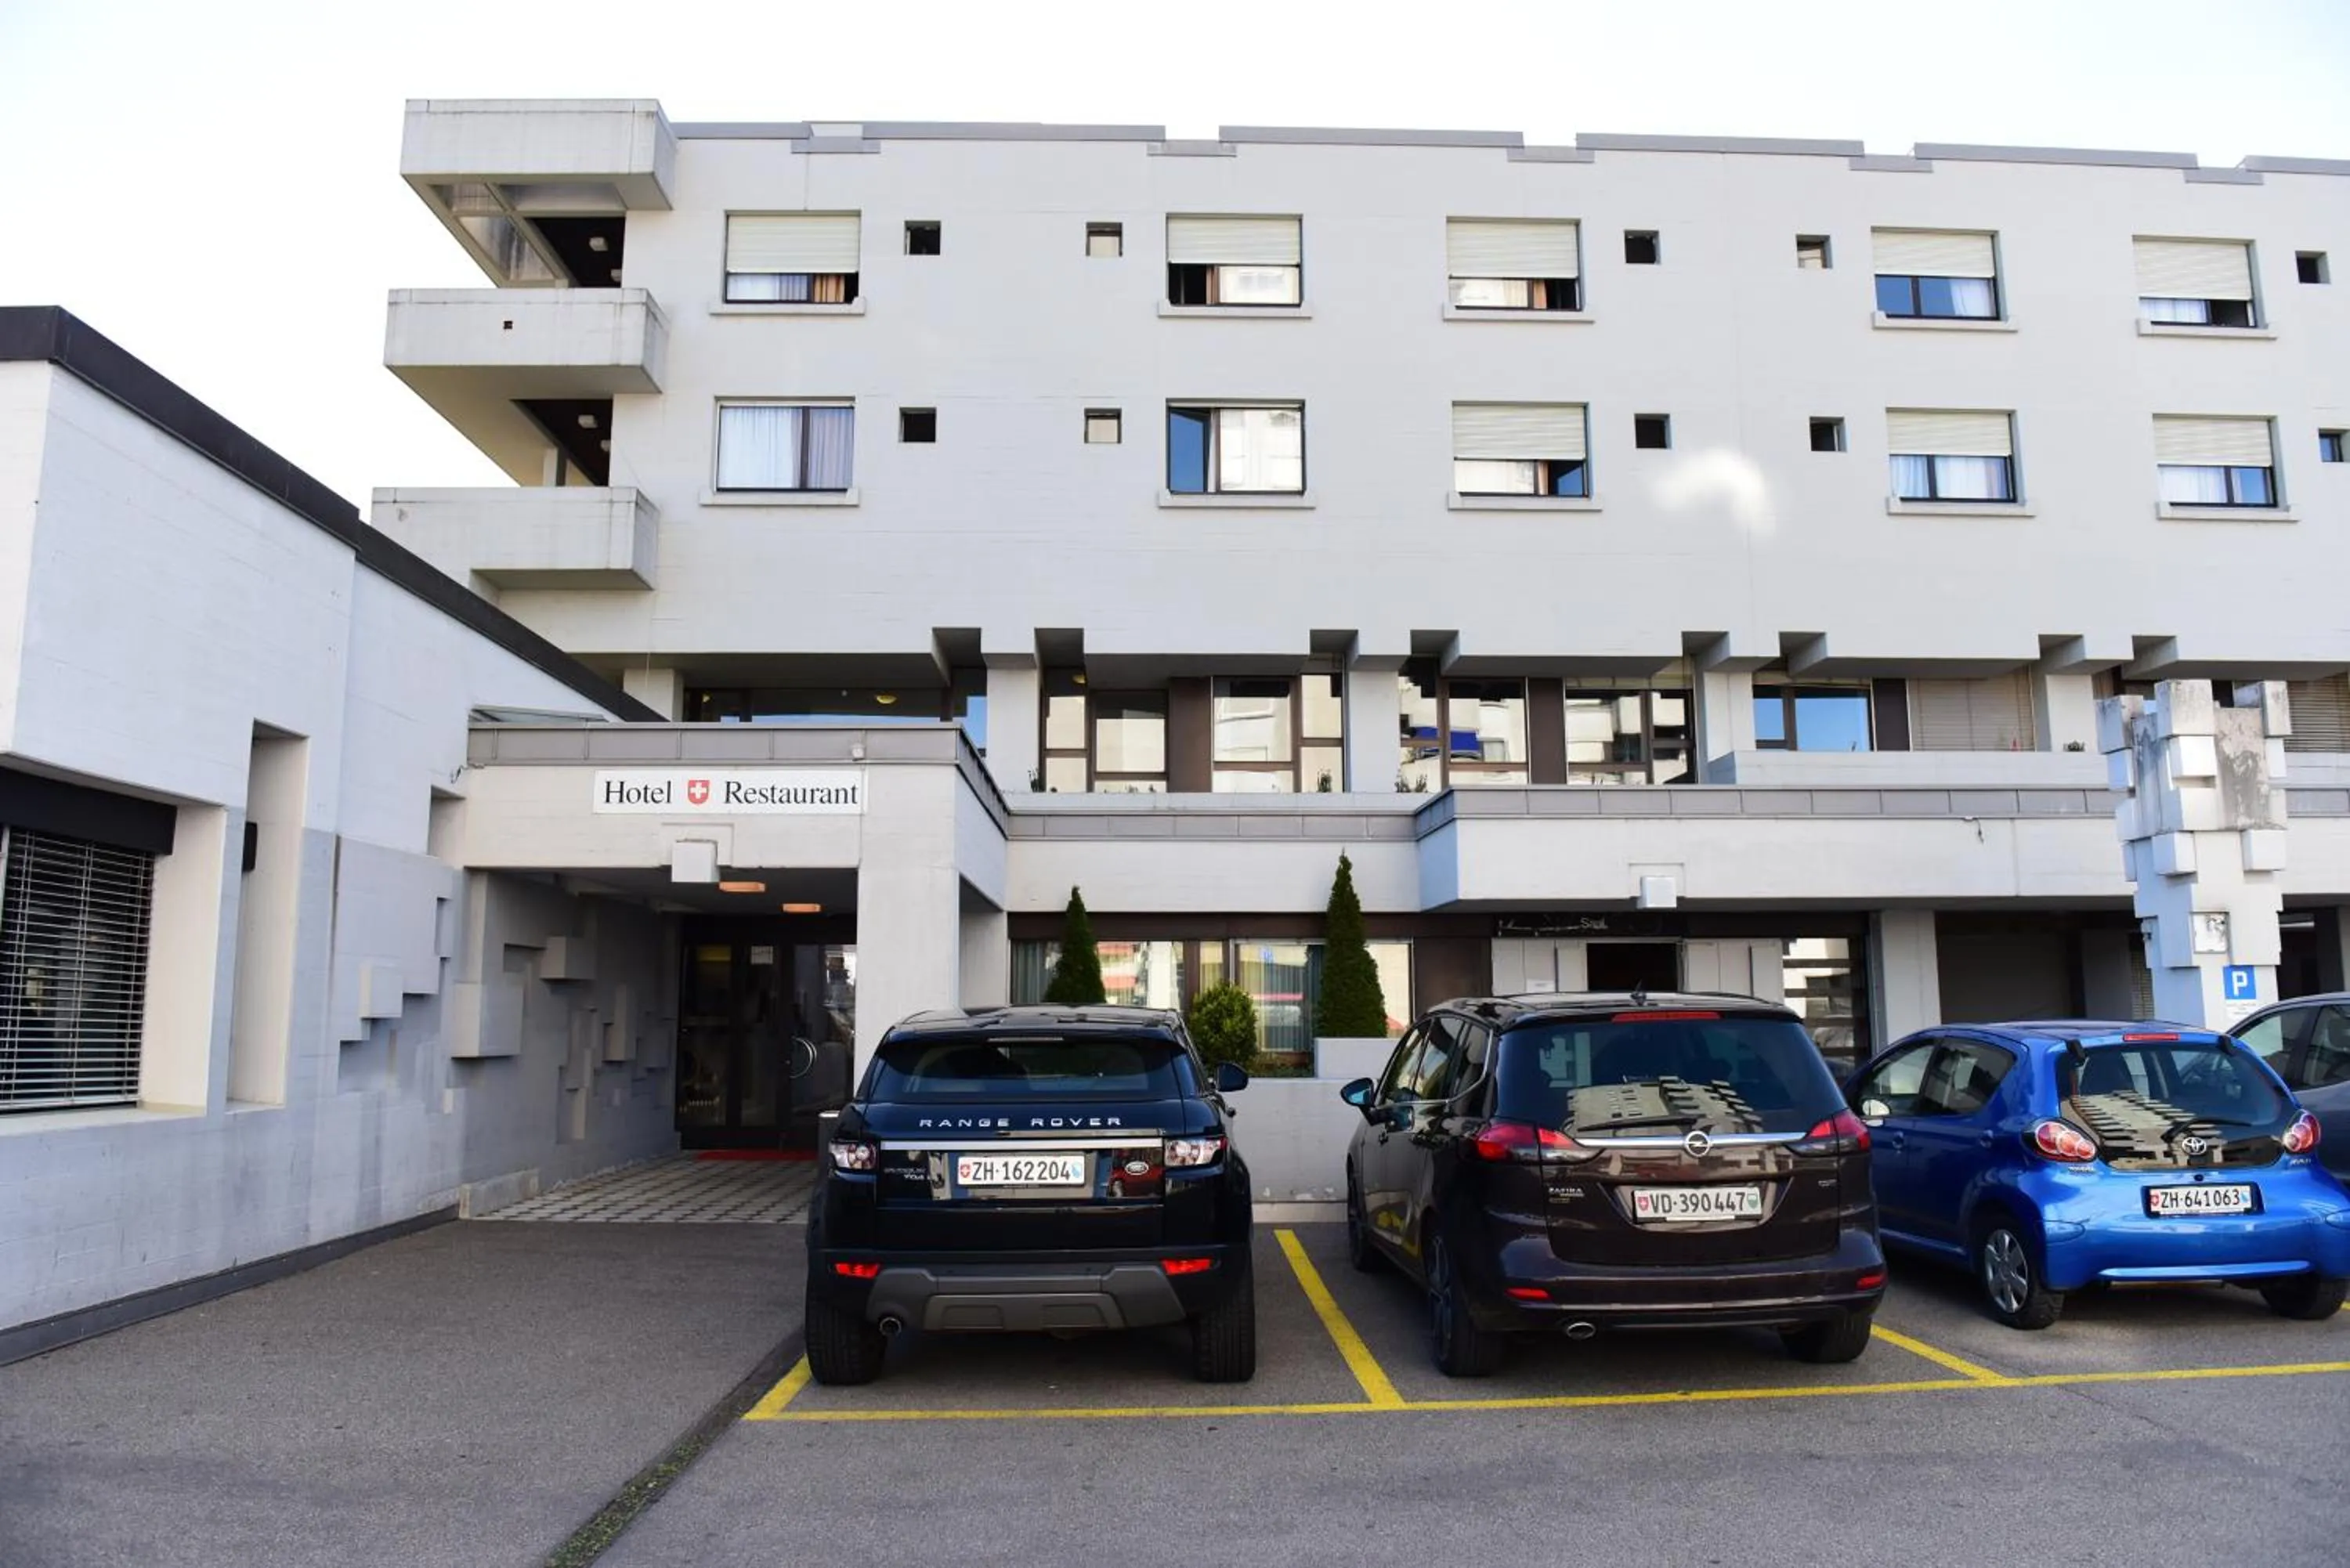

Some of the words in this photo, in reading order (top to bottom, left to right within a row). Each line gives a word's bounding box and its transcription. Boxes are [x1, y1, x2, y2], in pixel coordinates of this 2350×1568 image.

[605, 780, 671, 804] Hotel
[725, 780, 859, 804] Restaurant
[2232, 971, 2248, 996] P
[920, 1118, 1009, 1127] RANGE
[1031, 1118, 1121, 1126] ROVER
